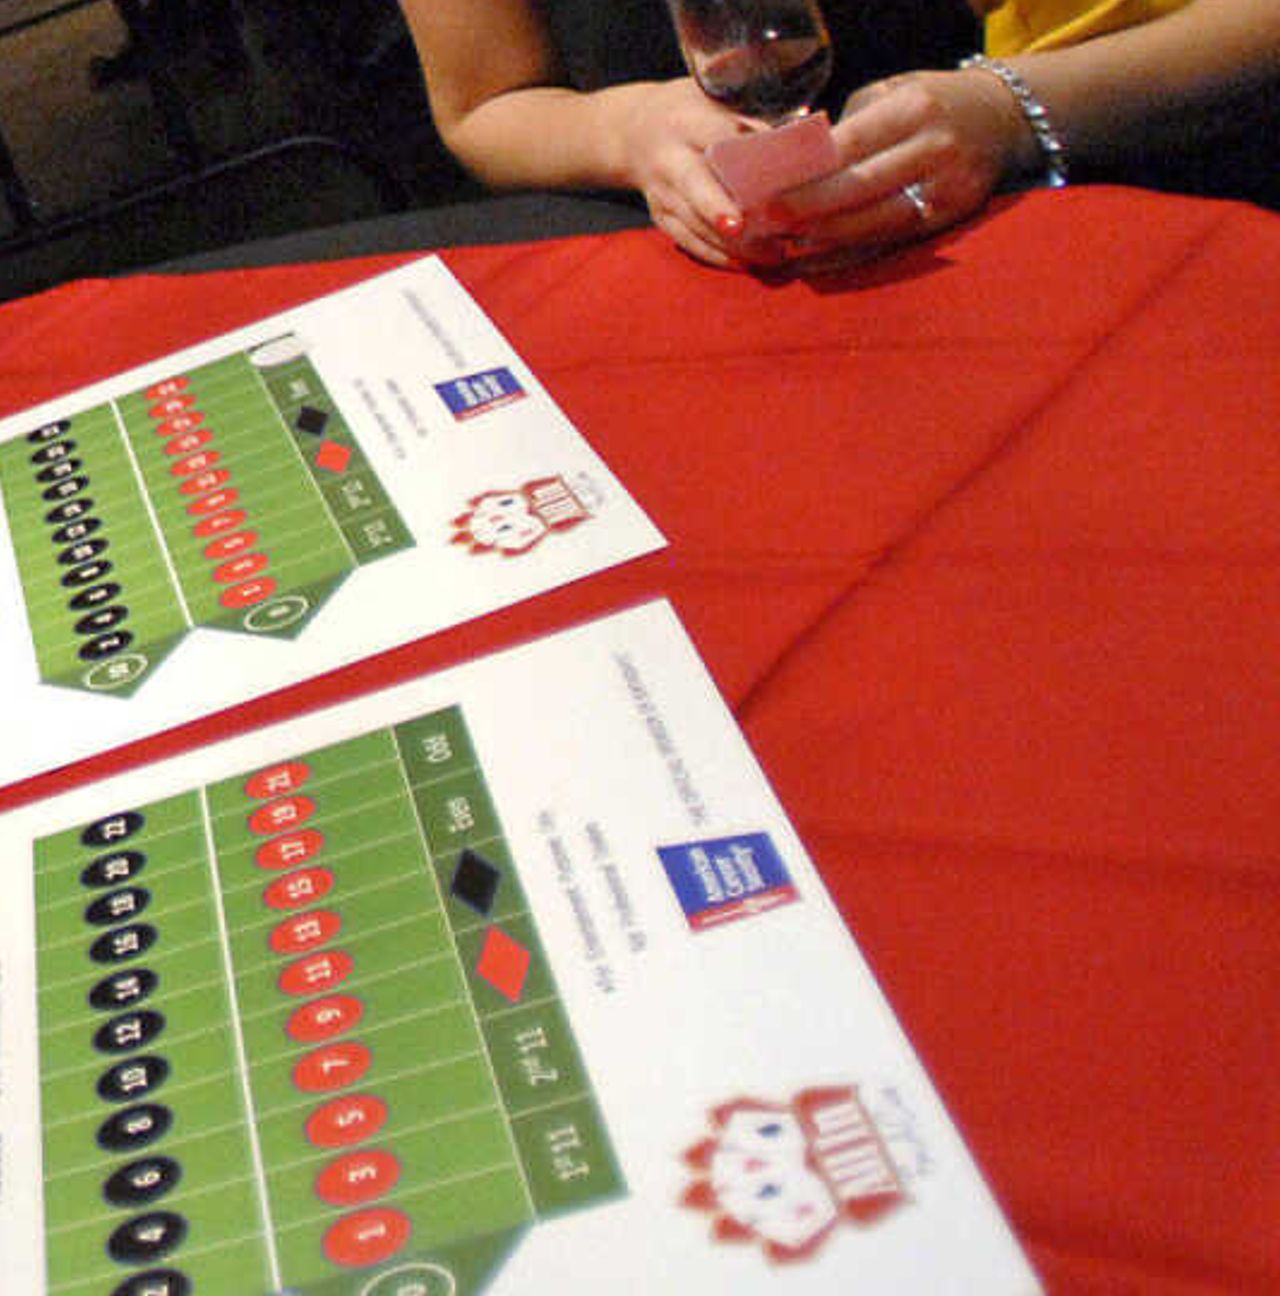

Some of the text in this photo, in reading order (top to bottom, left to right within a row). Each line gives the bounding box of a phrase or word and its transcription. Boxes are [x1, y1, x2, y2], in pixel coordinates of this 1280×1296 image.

[267, 770, 292, 794] 21
[272, 805, 296, 823] 19
[102, 815, 128, 838] 22
[280, 841, 307, 861] 17
[104, 856, 130, 879] 20
[288, 878, 313, 898] 15
[109, 893, 135, 915] 18
[293, 918, 320, 941] 13
[112, 930, 140, 953] 16
[306, 960, 330, 981] 11
[114, 977, 141, 999] 14
[317, 1009, 340, 1022] 9
[116, 1021, 140, 1043] 12
[323, 1060, 348, 1072] 7
[120, 1067, 147, 1091] 10
[125, 1116, 152, 1135] 8
[337, 1110, 364, 1126] 5
[133, 1171, 159, 1186] 6
[349, 1166, 376, 1182] 3
[138, 1227, 164, 1241] 4
[358, 1224, 385, 1240] 1
